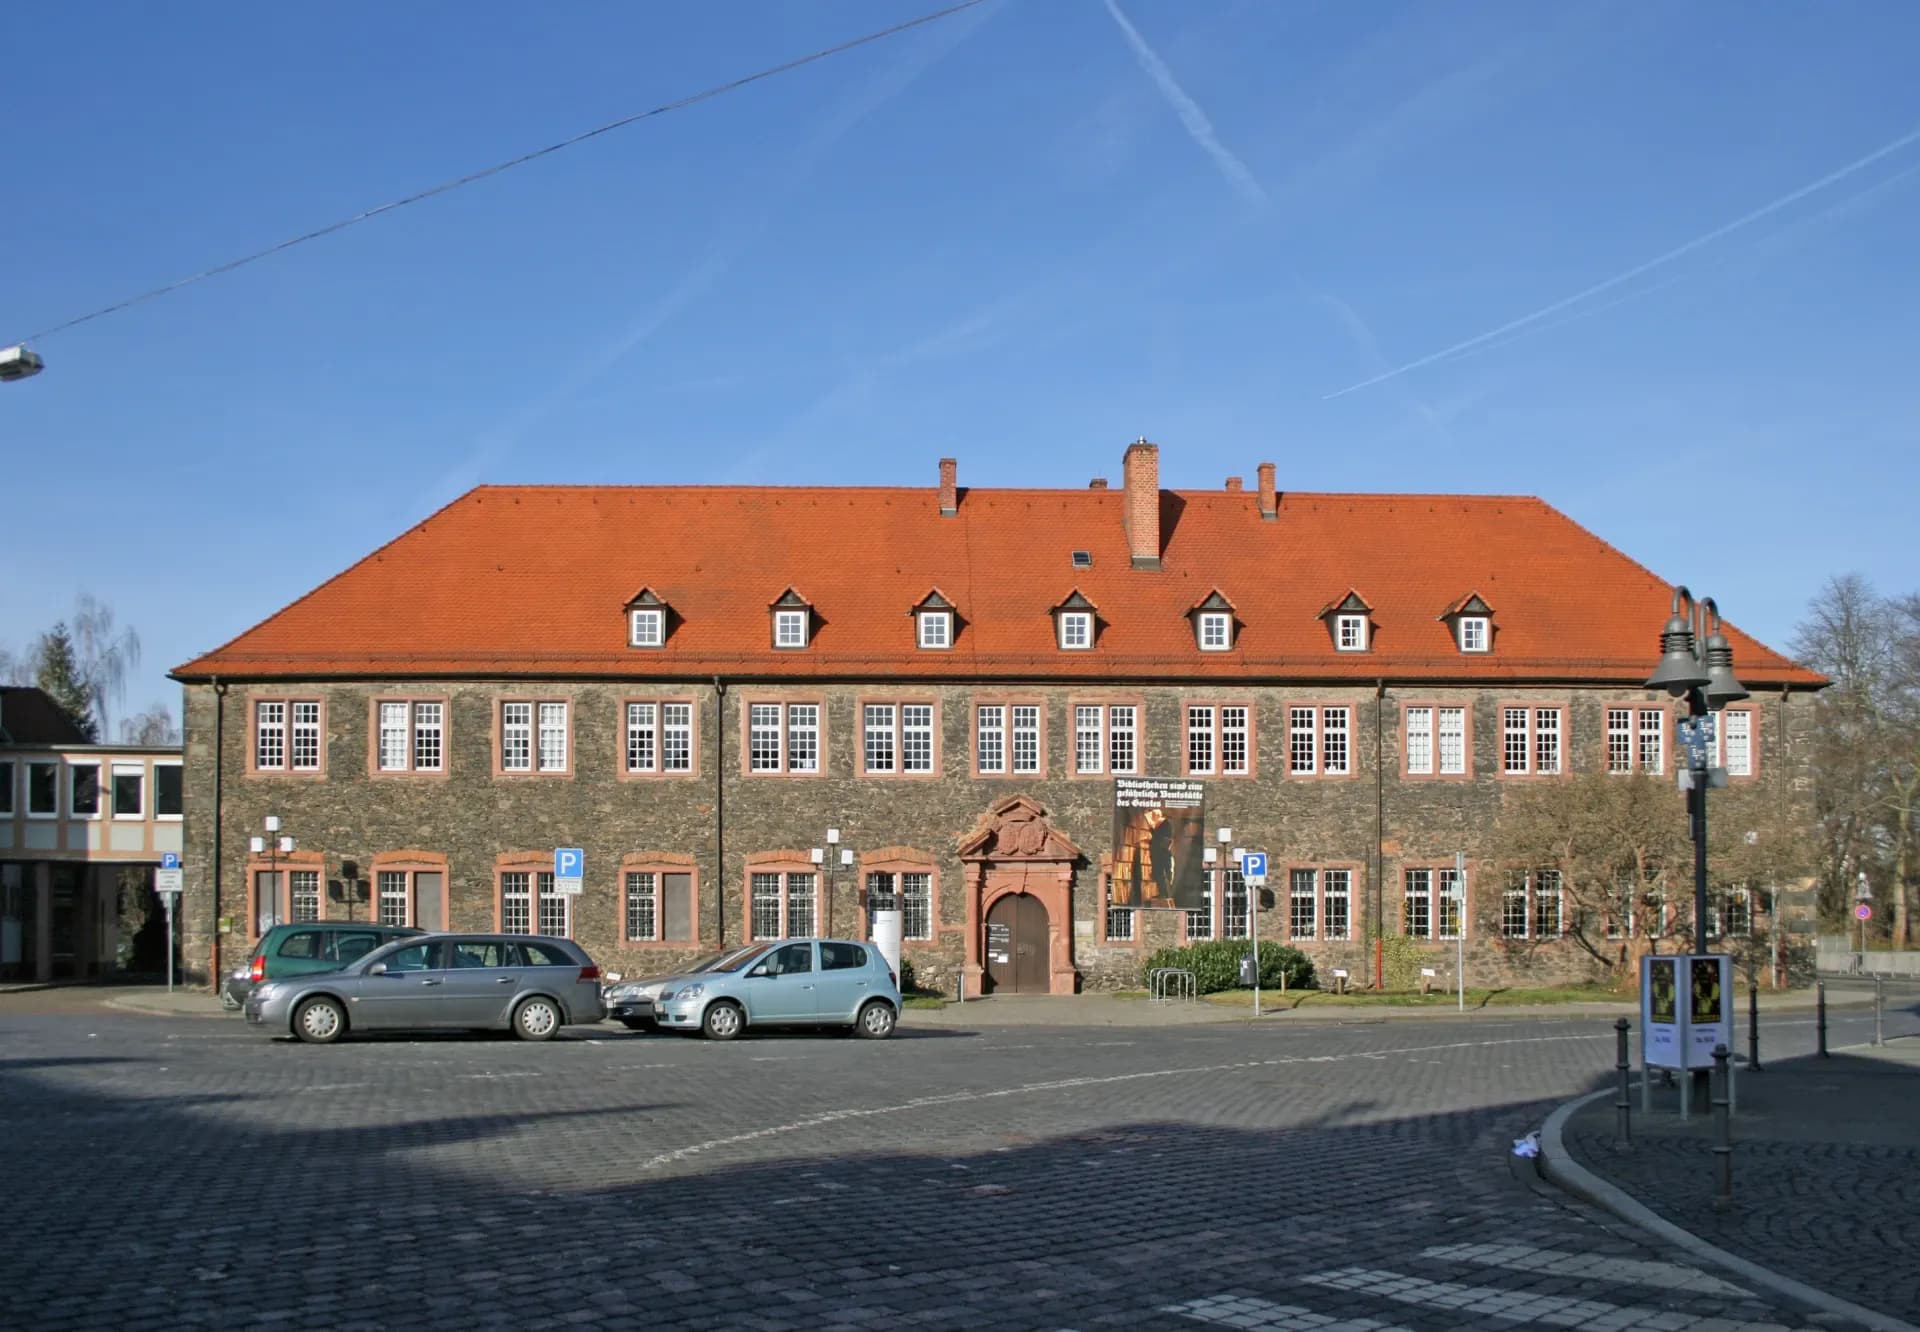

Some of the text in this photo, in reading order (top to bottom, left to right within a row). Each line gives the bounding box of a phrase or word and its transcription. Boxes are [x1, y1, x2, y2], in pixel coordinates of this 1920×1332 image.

[1117, 780, 1203, 791] Bibliotheken sind eine
[1116, 789, 1158, 799] gefährliche
[1116, 799, 1130, 807] des
[1131, 799, 1161, 808] Geistes
[165, 854, 175, 867] P
[561, 852, 577, 875] P
[1248, 856, 1260, 875] P
